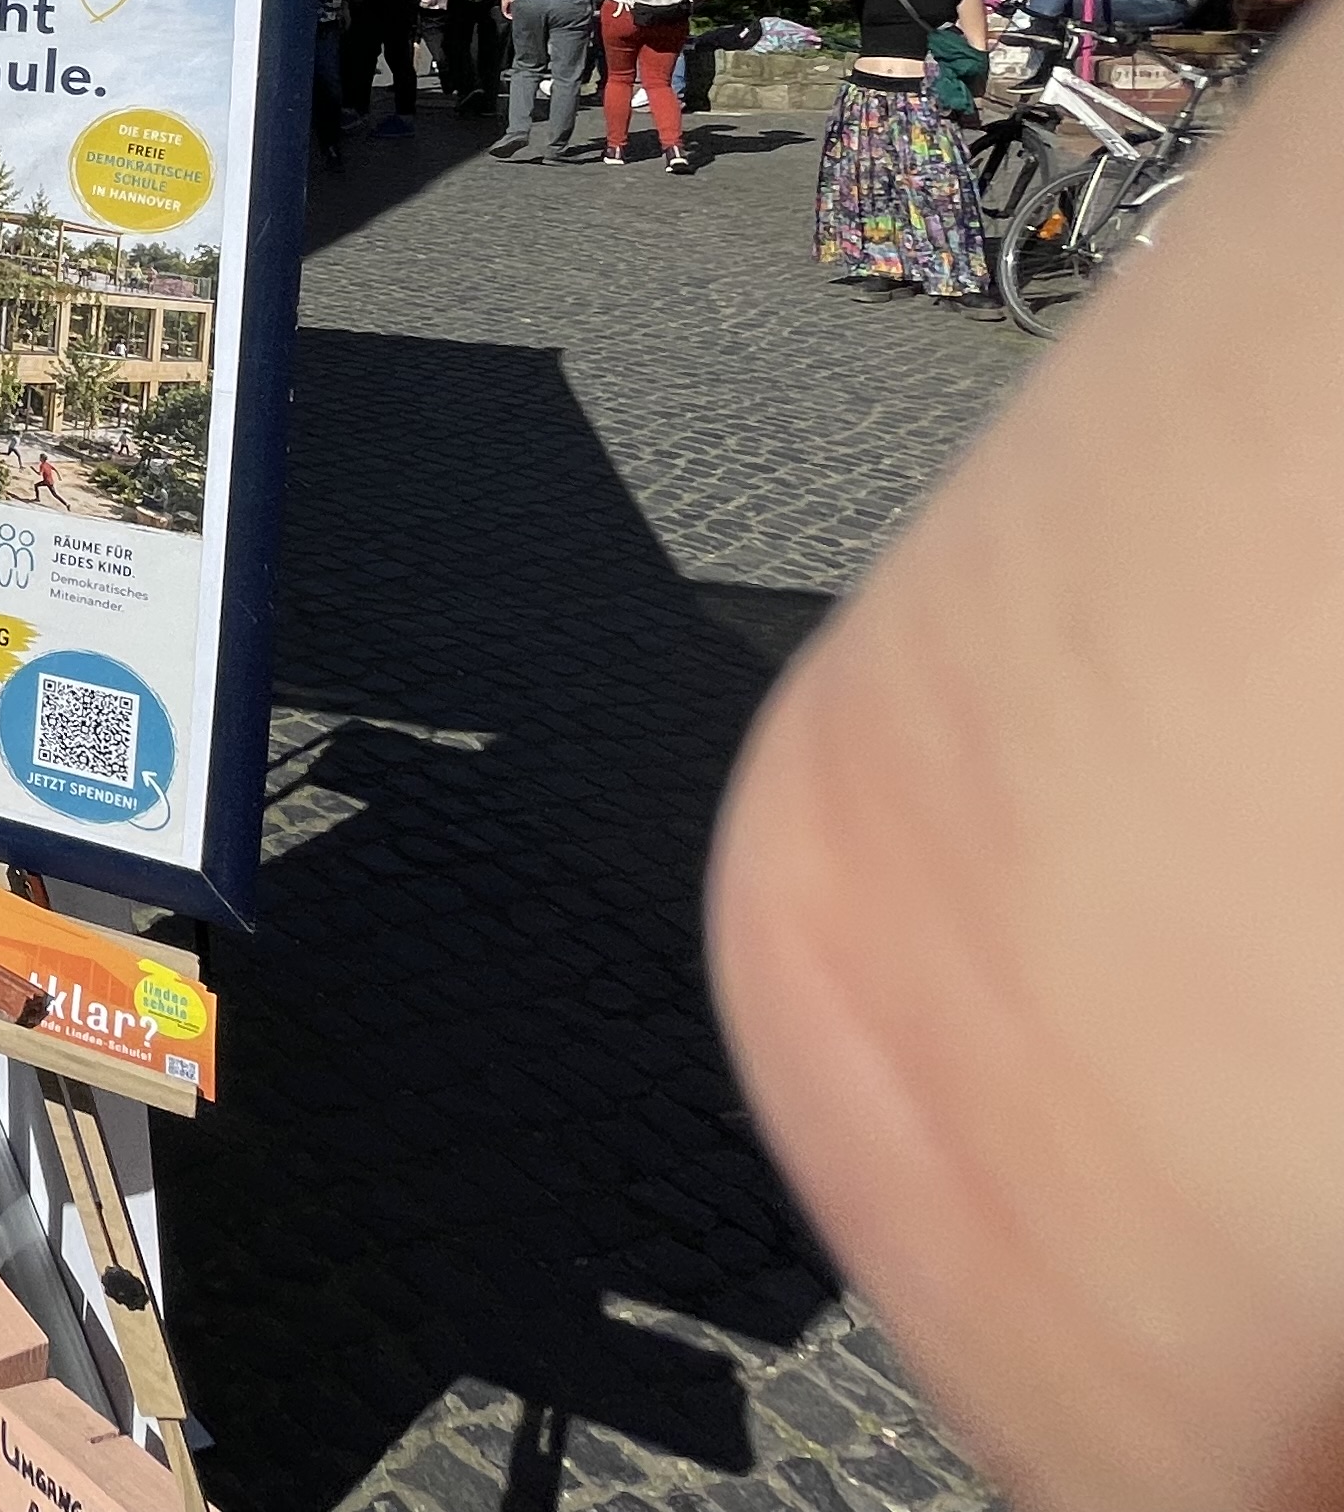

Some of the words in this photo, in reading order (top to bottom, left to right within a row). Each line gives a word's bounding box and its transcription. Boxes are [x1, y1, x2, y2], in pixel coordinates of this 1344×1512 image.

[118, 124, 139, 138] DIE
[142, 128, 183, 146] ERSTE
[127, 143, 166, 160] FREIE
[86, 151, 203, 183] DEMOKRATISCHE
[113, 172, 168, 192] SCHULE
[92, 185, 106, 197] IN
[109, 187, 181, 212] HANNOVER
[54, 534, 101, 555] RÄUME
[106, 544, 133, 561] FÜR
[51, 552, 94, 570] JEDES
[98, 561, 136, 579] KIND.
[50, 571, 149, 602] Demokratisches
[50, 587, 124, 613] Miteinander.
[26, 772, 66, 792] JETZT
[69, 782, 138, 811] SPENDEN!
[142, 980, 189, 1006] linden
[142, 996, 188, 1020] schule
[65, 1024, 153, 1062] Linden-Schule!
